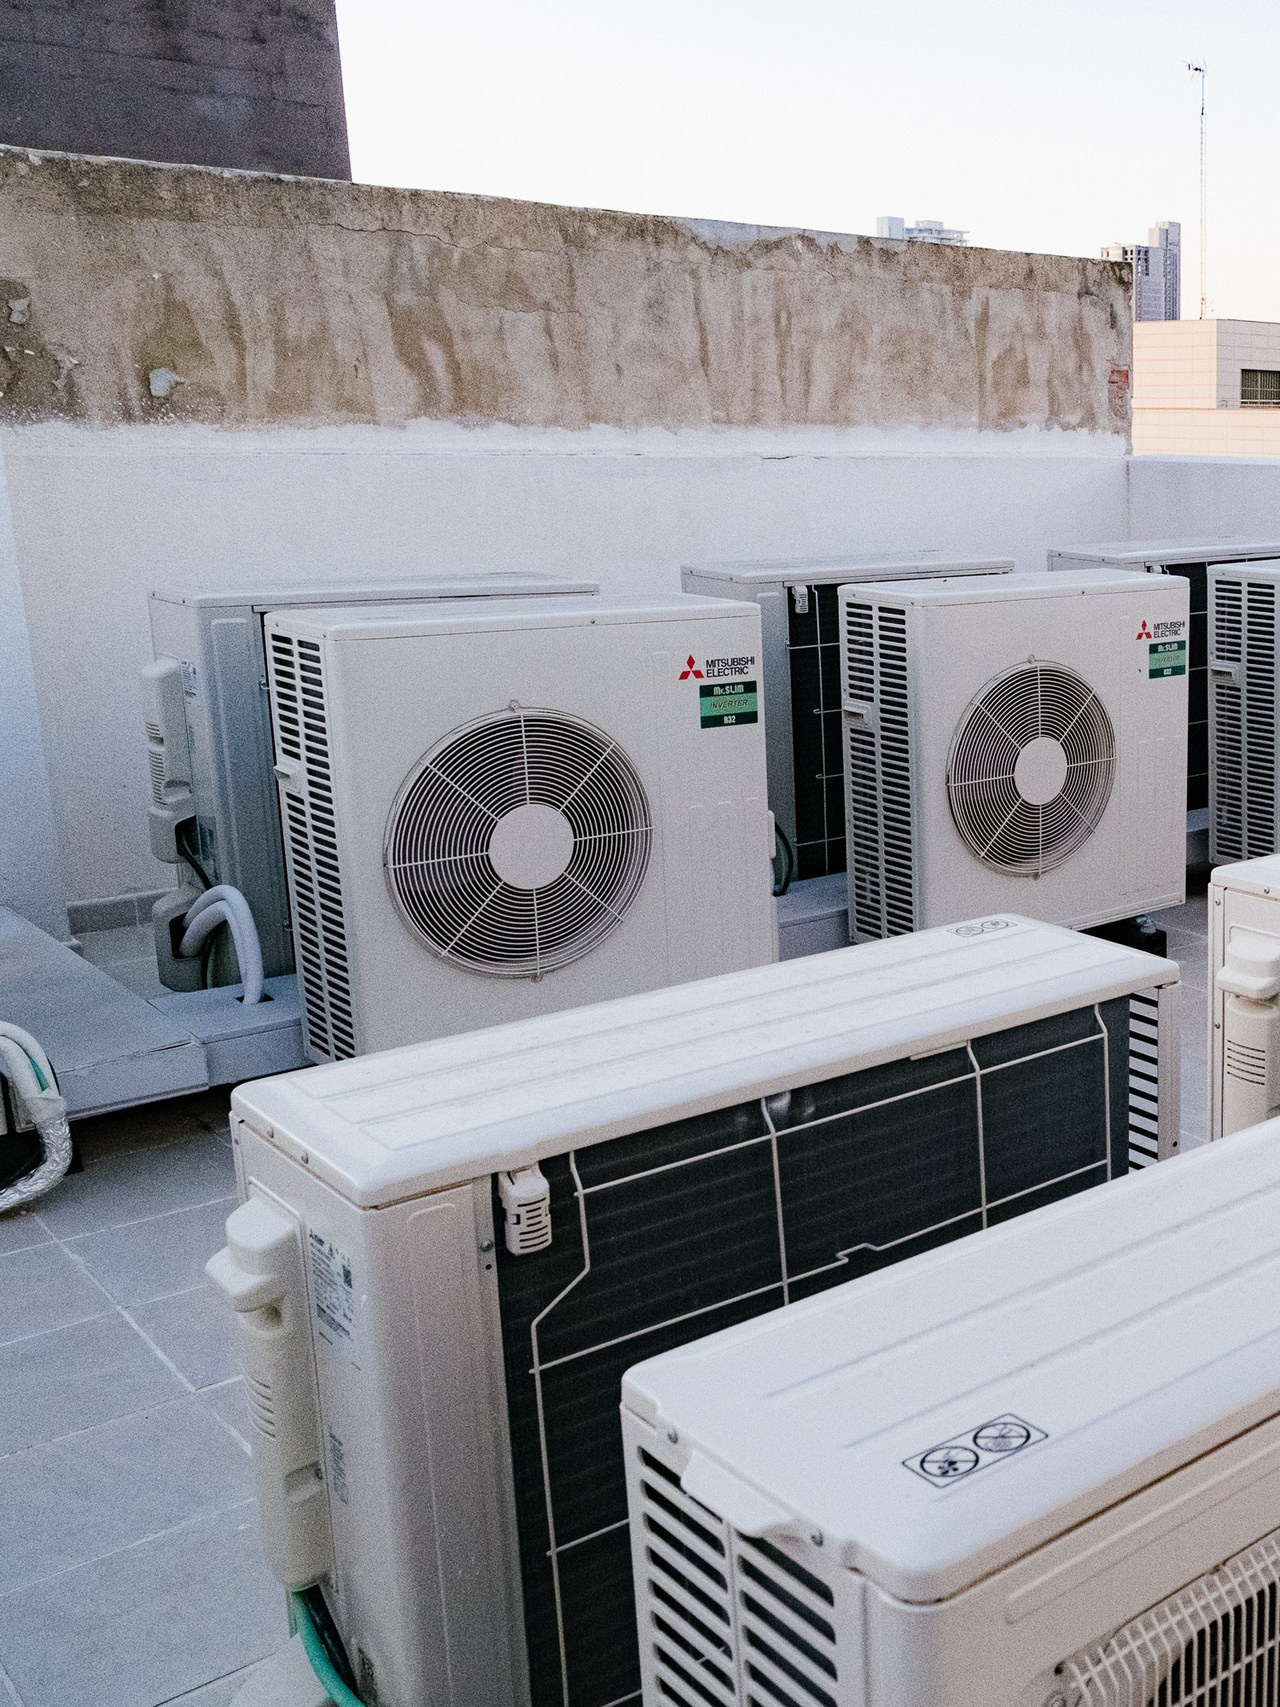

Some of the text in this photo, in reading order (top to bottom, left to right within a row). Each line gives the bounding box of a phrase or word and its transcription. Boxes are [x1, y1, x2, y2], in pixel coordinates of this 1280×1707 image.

[1153, 621, 1185, 631] MITSUBISHI
[1153, 629, 1181, 638] ELECTRIC
[705, 656, 755, 668] MITSUBISHI
[706, 666, 749, 678] ELECTRIC
[713, 684, 745, 695] Mr.SLIM
[711, 699, 748, 709] INVERTER
[723, 715, 736, 724] R32
